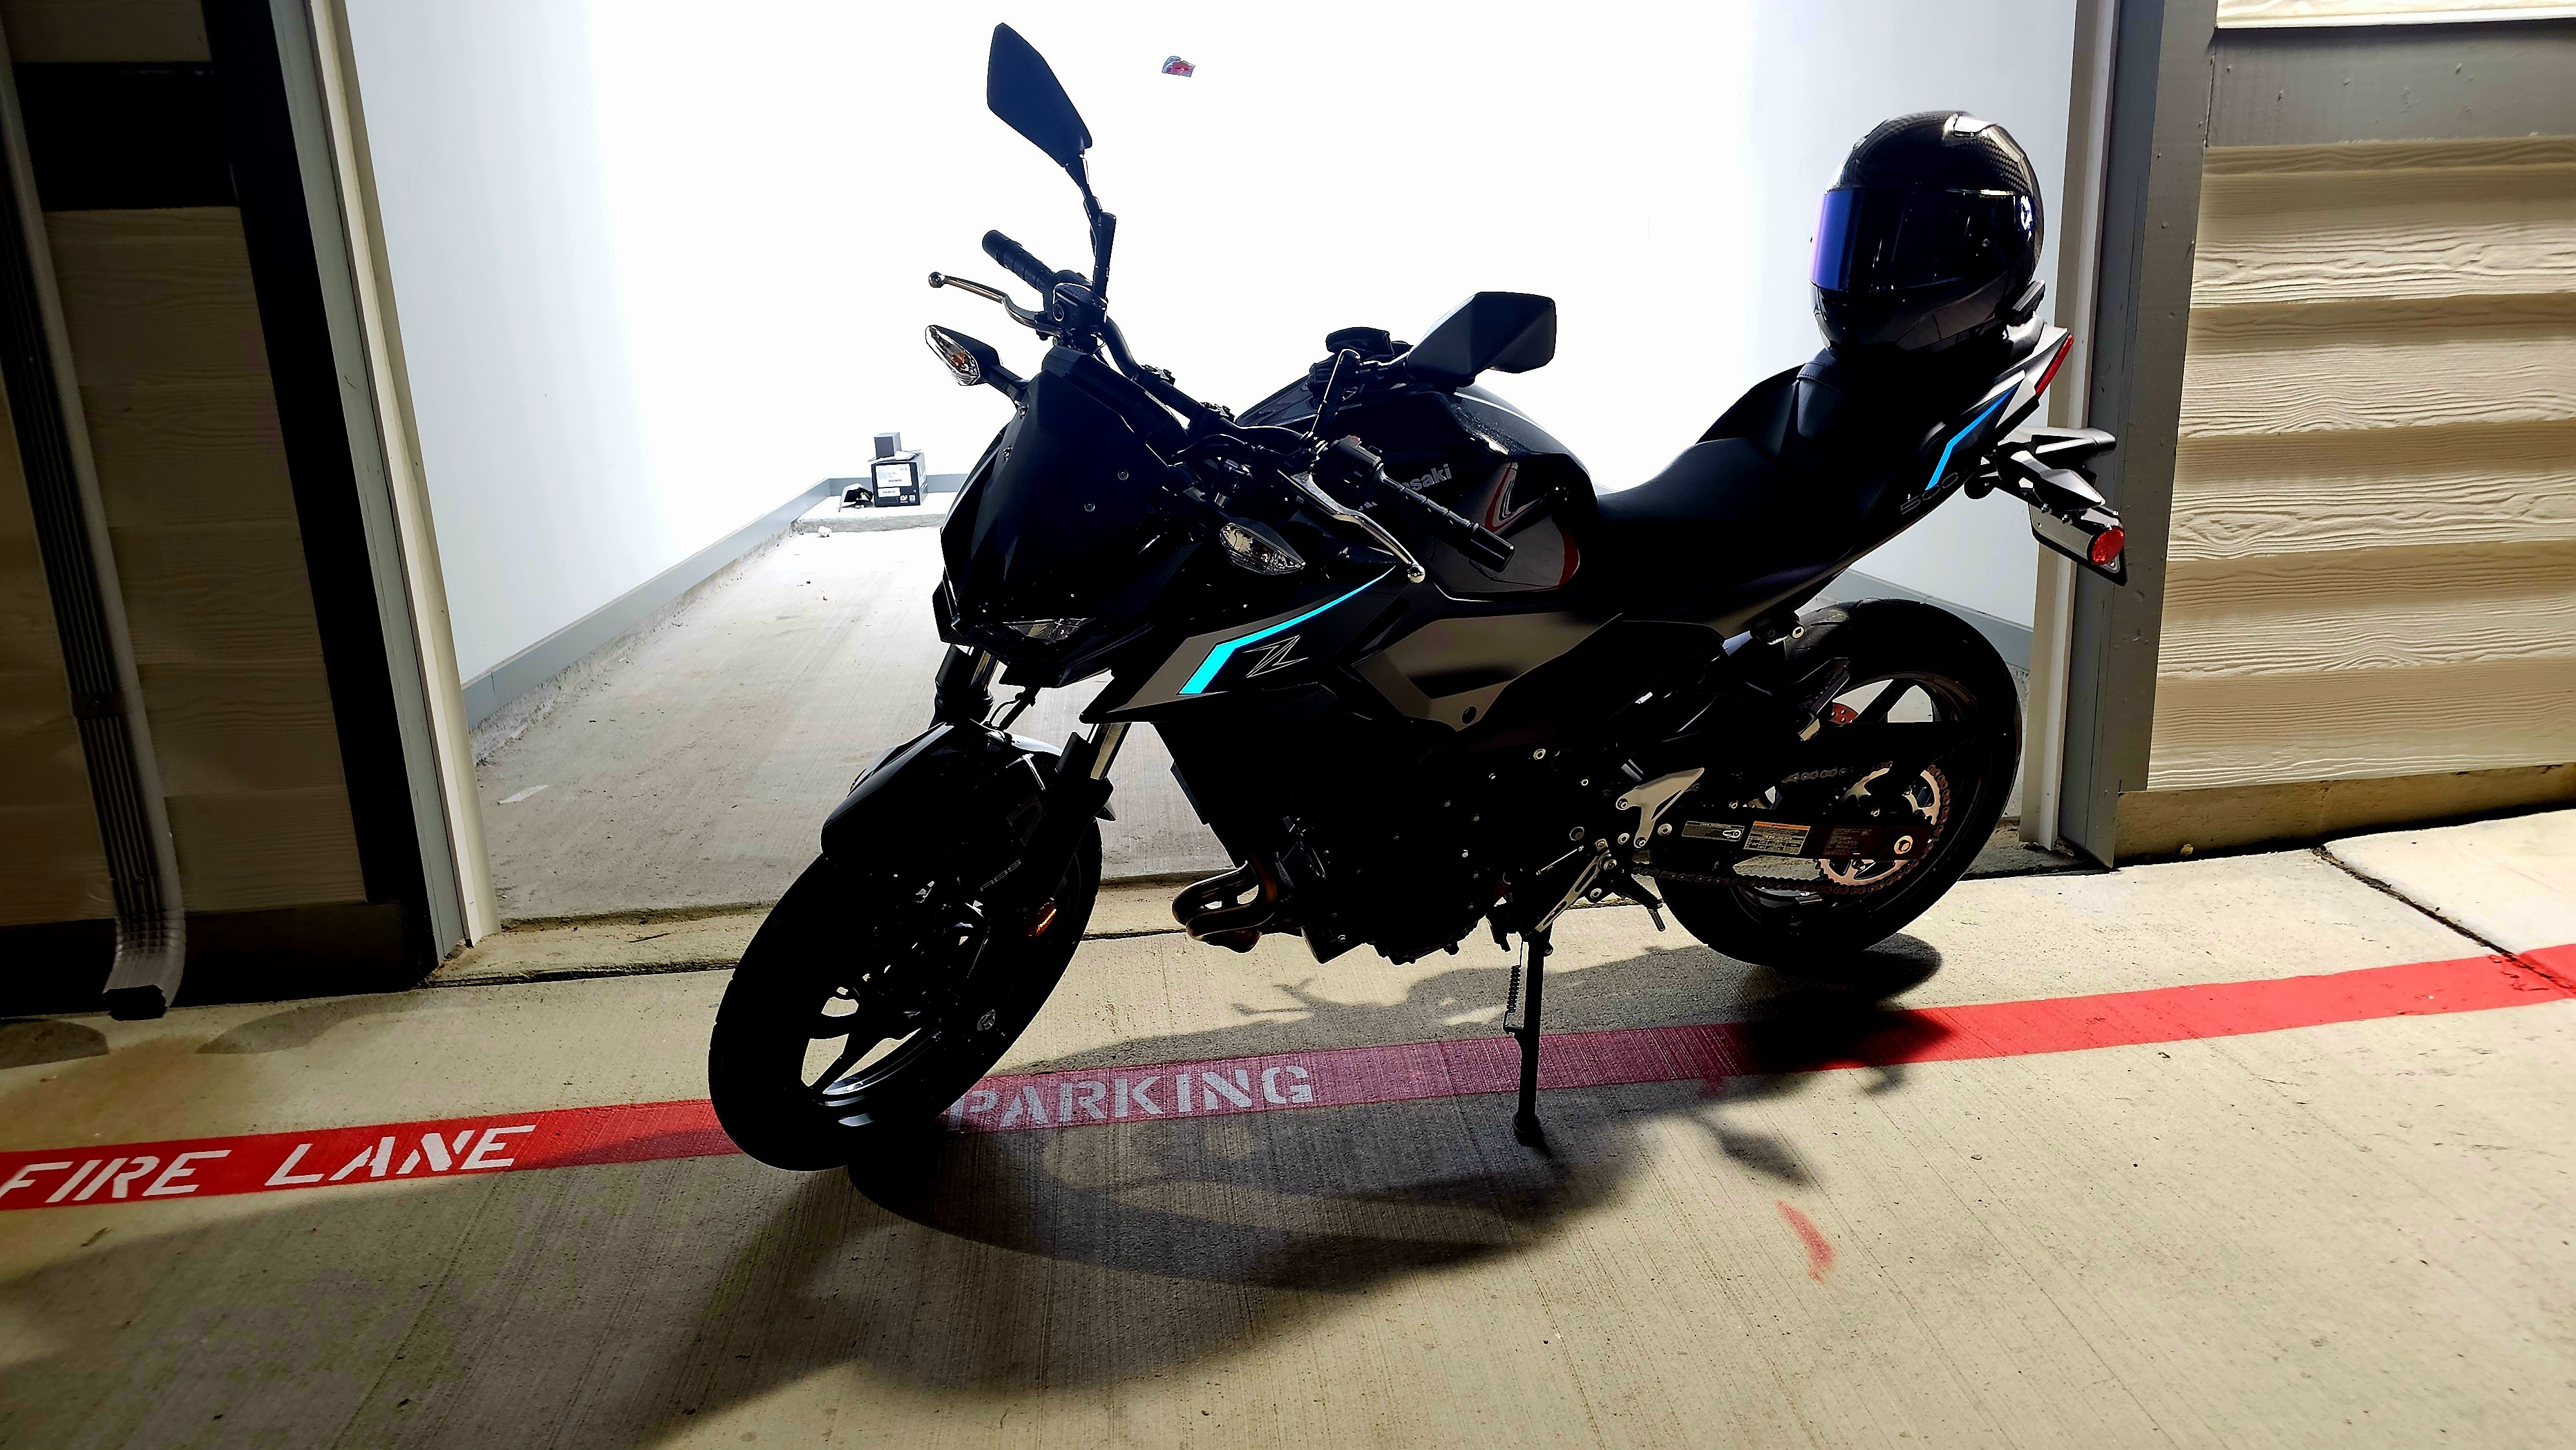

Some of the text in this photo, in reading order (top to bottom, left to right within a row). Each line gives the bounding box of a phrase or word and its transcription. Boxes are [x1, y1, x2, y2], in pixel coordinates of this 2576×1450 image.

[1900, 472, 1958, 514] 500
[0, 1064, 1314, 1203] FIRE LANE PARKING
